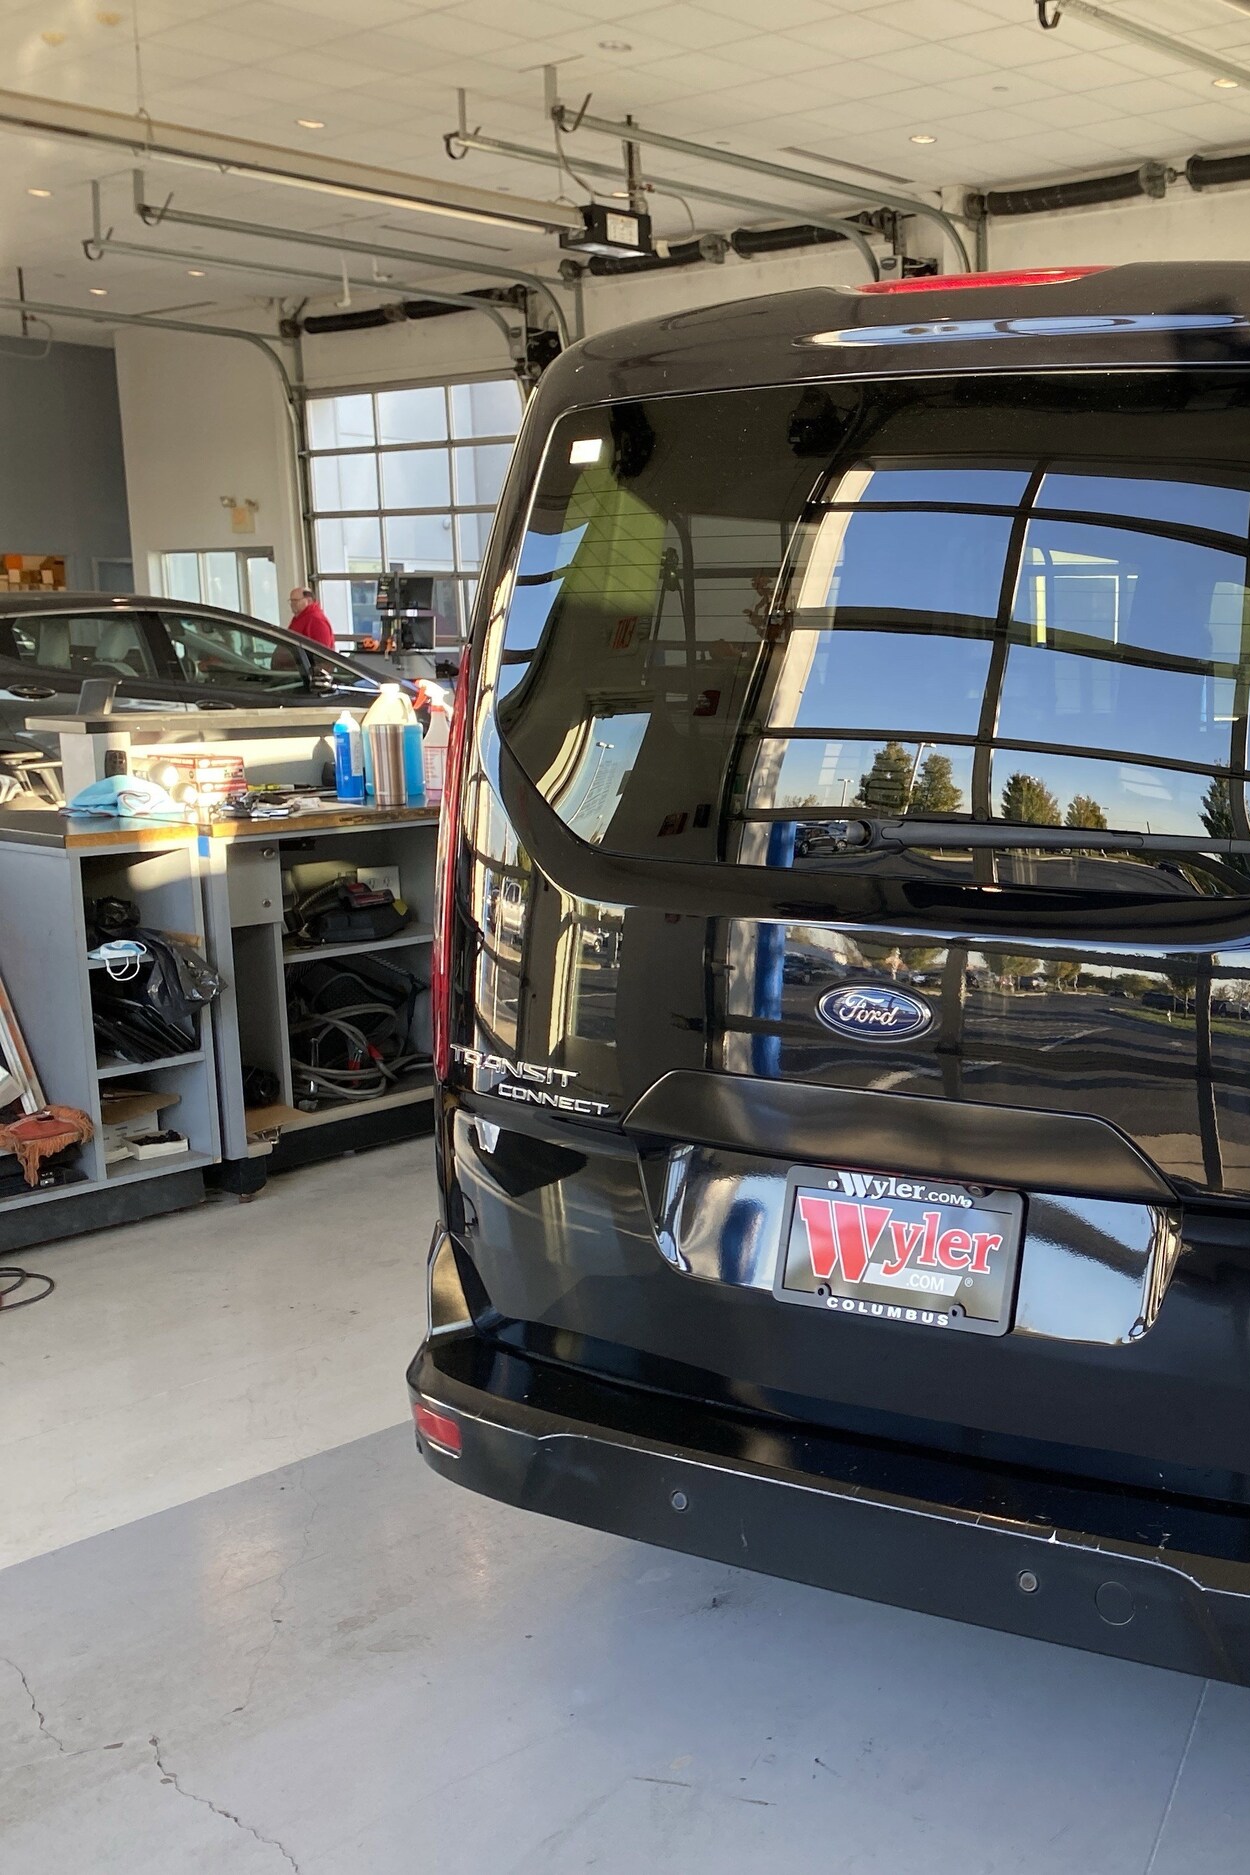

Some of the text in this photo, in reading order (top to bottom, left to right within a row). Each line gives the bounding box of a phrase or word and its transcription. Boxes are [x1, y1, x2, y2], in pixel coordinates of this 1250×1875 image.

[839, 992, 900, 1026] Ford
[450, 1043, 580, 1088] TRANSIT
[498, 1083, 610, 1116] CONNECT
[798, 1195, 1003, 1284] Wyler
[826, 1296, 950, 1327] COLUMBUS
